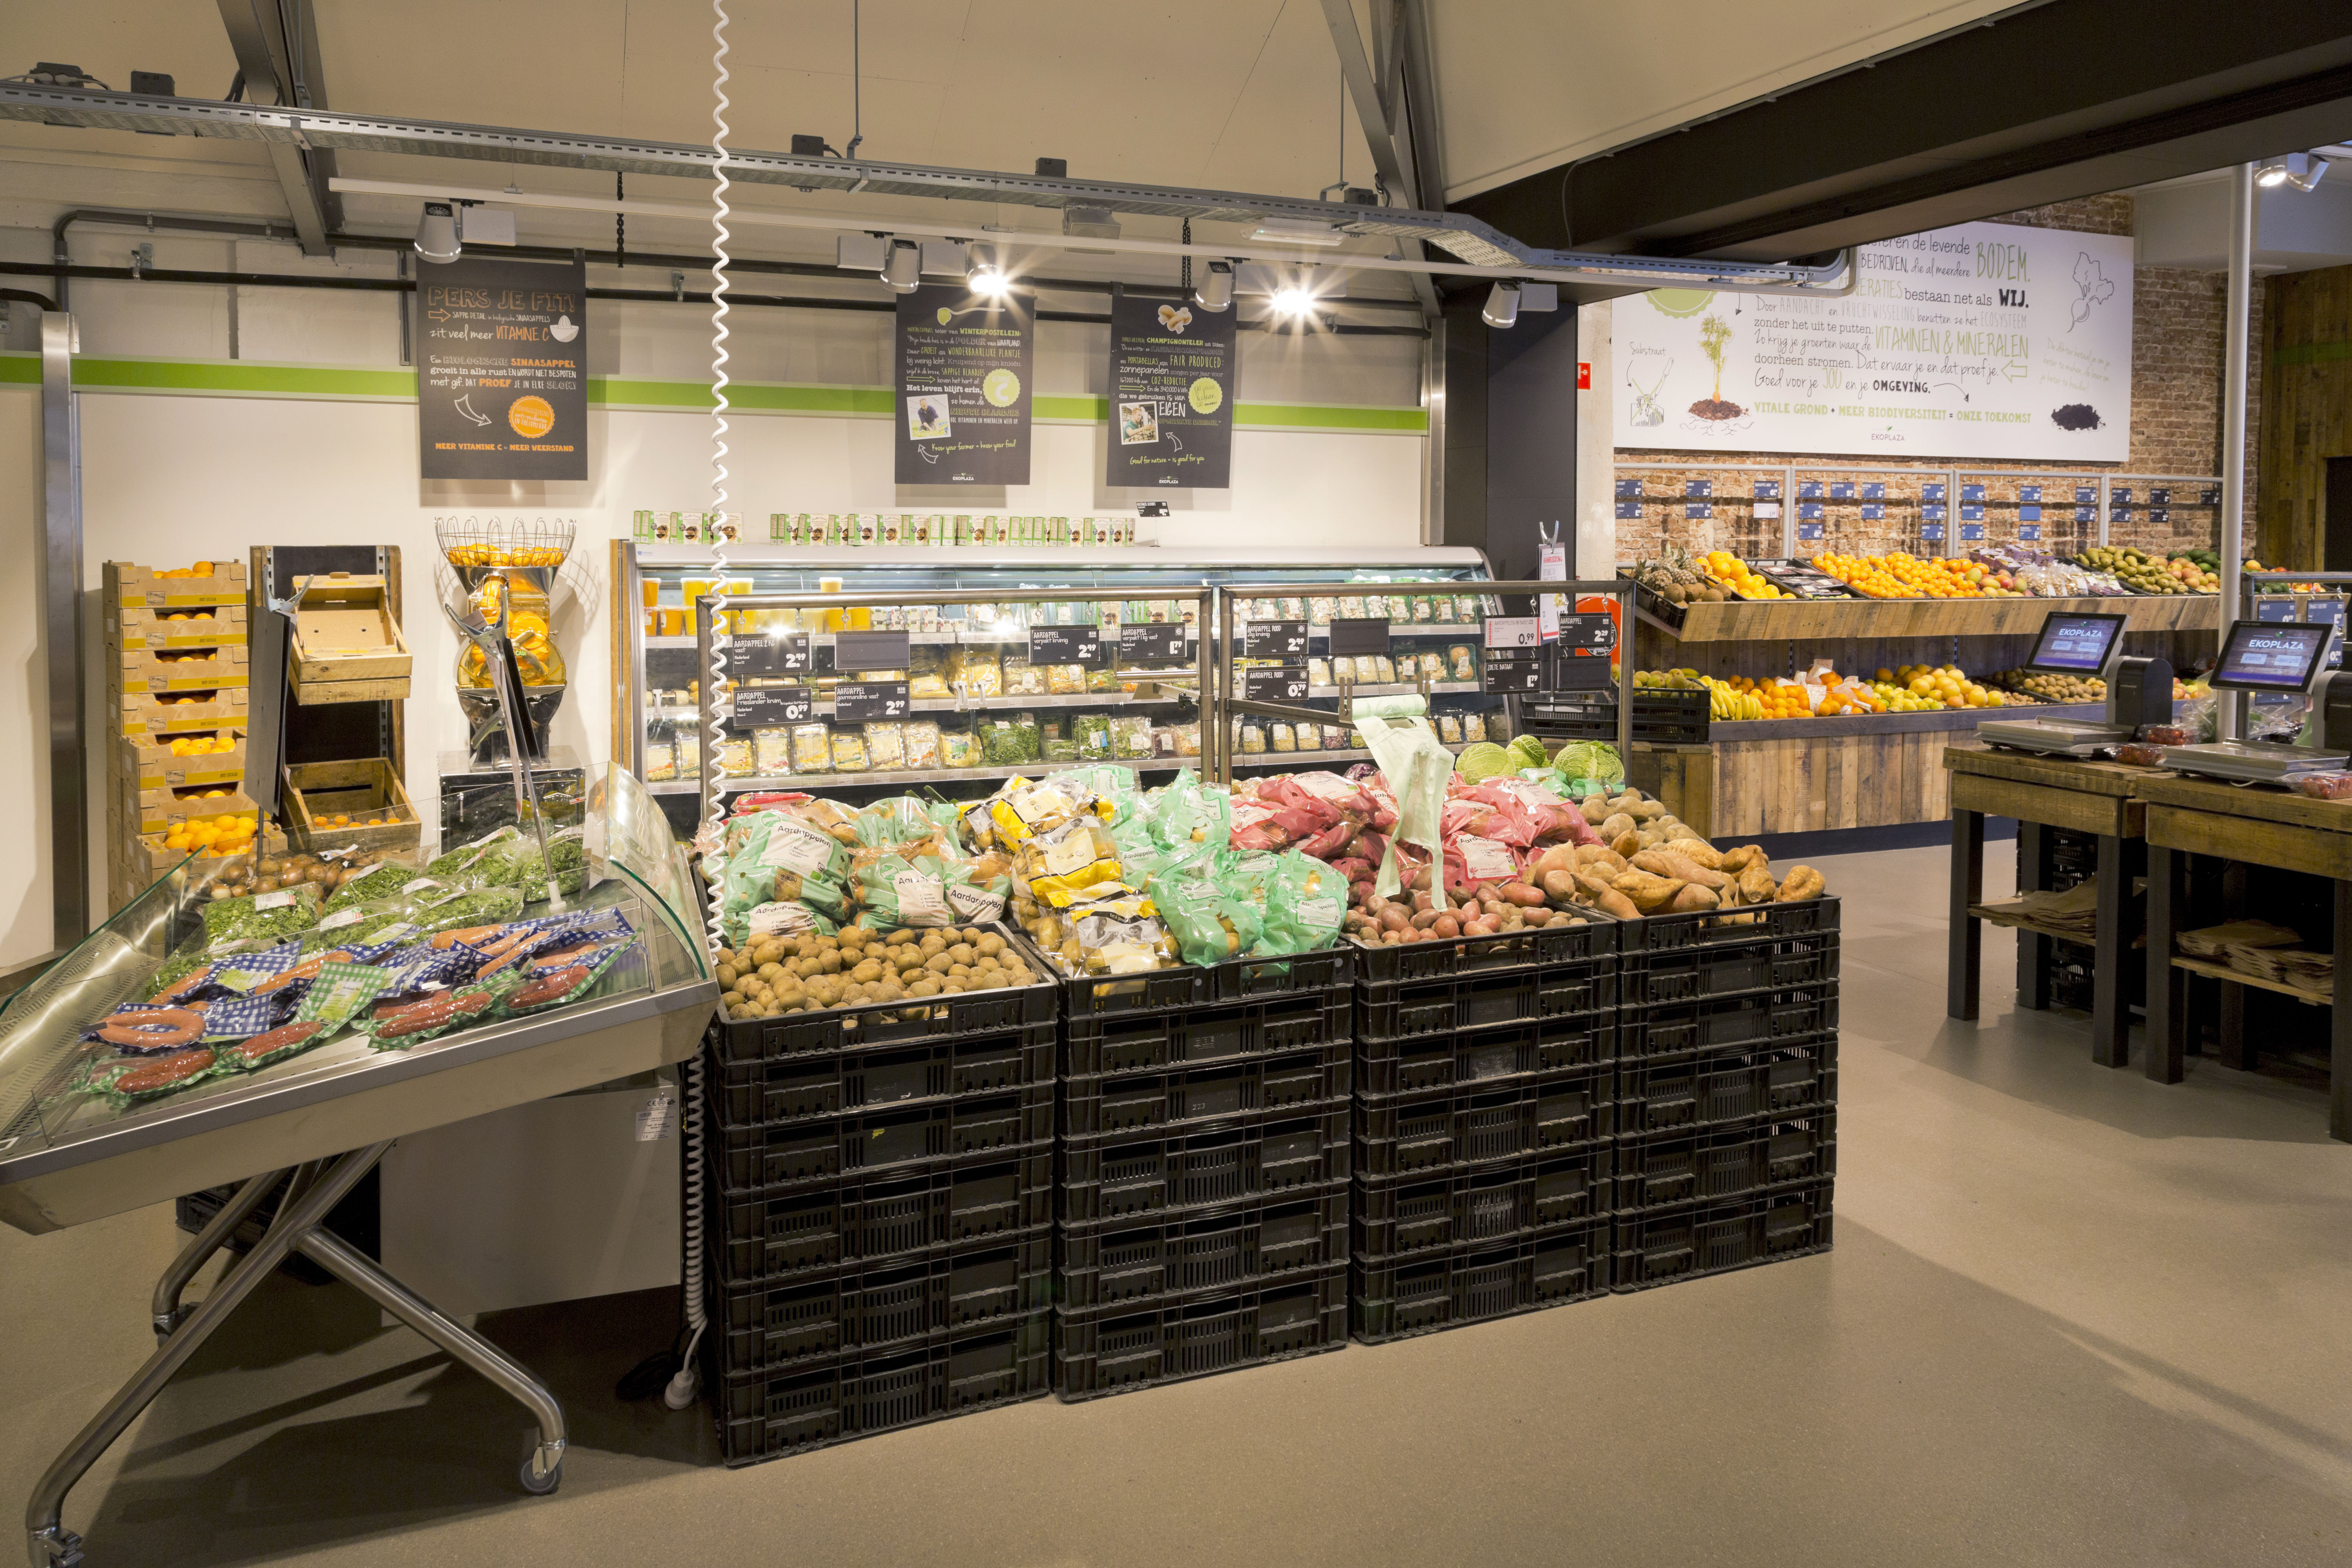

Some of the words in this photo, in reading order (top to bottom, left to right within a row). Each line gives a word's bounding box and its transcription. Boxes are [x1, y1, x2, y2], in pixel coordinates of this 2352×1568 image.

[1912, 233, 1926, 250] de
[1930, 234, 1970, 254] levende
[1976, 241, 2030, 282] BODEM.
[1861, 253, 1909, 274] BEDRIJVEN,
[1911, 256, 1924, 273] die
[1926, 258, 1934, 277] al
[1936, 261, 1971, 277] meerdere
[429, 287, 490, 308] PERS
[498, 290, 525, 310] JE
[532, 292, 575, 312] FIT!
[1904, 288, 1950, 303] bestaan
[1954, 292, 1973, 305] net
[1976, 294, 1992, 306] als
[1998, 288, 2029, 308] WIJ.
[430, 328, 447, 338] zit
[449, 324, 468, 341] veel
[470, 331, 494, 339] meer
[496, 325, 539, 341] VITAMINE
[542, 327, 549, 341] C
[960, 328, 1021, 336] WINTERPOSTELEIN:
[1755, 318, 1789, 329] zonder
[1792, 319, 1808, 330] het
[1811, 322, 1824, 331] uit
[1827, 322, 1836, 332] te
[1839, 324, 1874, 334] putten.
[1147, 337, 1203, 346] CHAMPIGNONTELER
[1754, 328, 1765, 344] Zo
[1768, 329, 1788, 354] krijg
[1789, 335, 1798, 353] je
[1801, 338, 1837, 355] groenten
[1840, 341, 1859, 350] waar
[1862, 335, 1871, 351] de
[1875, 325, 1939, 354] VITAMINEN
[1944, 330, 1953, 355] &
[1957, 331, 2028, 359] MINERALEN
[948, 347, 996, 357] WONDERBAARLIJKE
[999, 349, 1020, 358] PLANTJE
[1629, 342, 1666, 356] Substraat
[430, 355, 442, 363] Een
[443, 356, 508, 366] BIOLOGISCHE
[511, 358, 575, 368] SINAASAPPEL
[1170, 354, 1185, 367] FAIR
[1189, 355, 1224, 368] PRODUCED:
[1755, 353, 1804, 366] doorheen
[1808, 357, 1853, 368] stromen.
[1855, 350, 1878, 370] Dat
[1881, 359, 1913, 372] ervaar
[1913, 360, 1924, 381] je
[1927, 363, 1938, 373] en
[1940, 356, 1960, 376] dat
[1961, 358, 1988, 384] proef
[548, 370, 576, 378] BESPOTEN
[963, 368, 985, 376] BLAADJES
[1120, 365, 1169, 376] zonnepanelen
[430, 376, 450, 386] met
[451, 376, 464, 389] gif.
[466, 378, 476, 386] DAT
[479, 378, 512, 388] PROEF
[532, 381, 544, 389] ELKE
[547, 381, 577, 390] SLOK!
[965, 386, 982, 394] erin,
[1755, 368, 1784, 388] Goed
[1786, 378, 1807, 388] voor
[1807, 376, 1818, 397] je
[1822, 367, 1842, 389] JOU
[1846, 381, 1857, 390] en
[1858, 379, 1869, 400] je
[1873, 380, 1931, 394] OMGEVING.
[1159, 401, 1185, 417] EIGEN
[1754, 402, 1790, 414] VITALE
[1794, 403, 1828, 415] GROND
[1838, 405, 1864, 417] MEER
[1868, 407, 1946, 420] BIODIVERSITEIT
[1957, 410, 1982, 421] ONZE
[1985, 412, 2031, 424] TOEKOMST
[1543, 555, 1563, 564] AANBIEDING
[1519, 633, 1534, 645] 0.99
[2058, 629, 2102, 637] EKOPLAZA
[734, 639, 763, 648] AARDAPPEL
[1288, 638, 1305, 651] 2.49
[2249, 640, 2303, 650] EKOPLAZA
[1078, 644, 1096, 658] 2.49
[786, 653, 806, 668] 2.49
[737, 692, 766, 700] AARDAPPEL
[1288, 684, 1306, 697] 0.79
[786, 704, 808, 719] 0.99
[886, 700, 905, 715] 2.99
[777, 826, 831, 847] Aardappelen
[1124, 850, 1156, 859] Aardappelen
[950, 890, 1002, 910] Aardappelen
